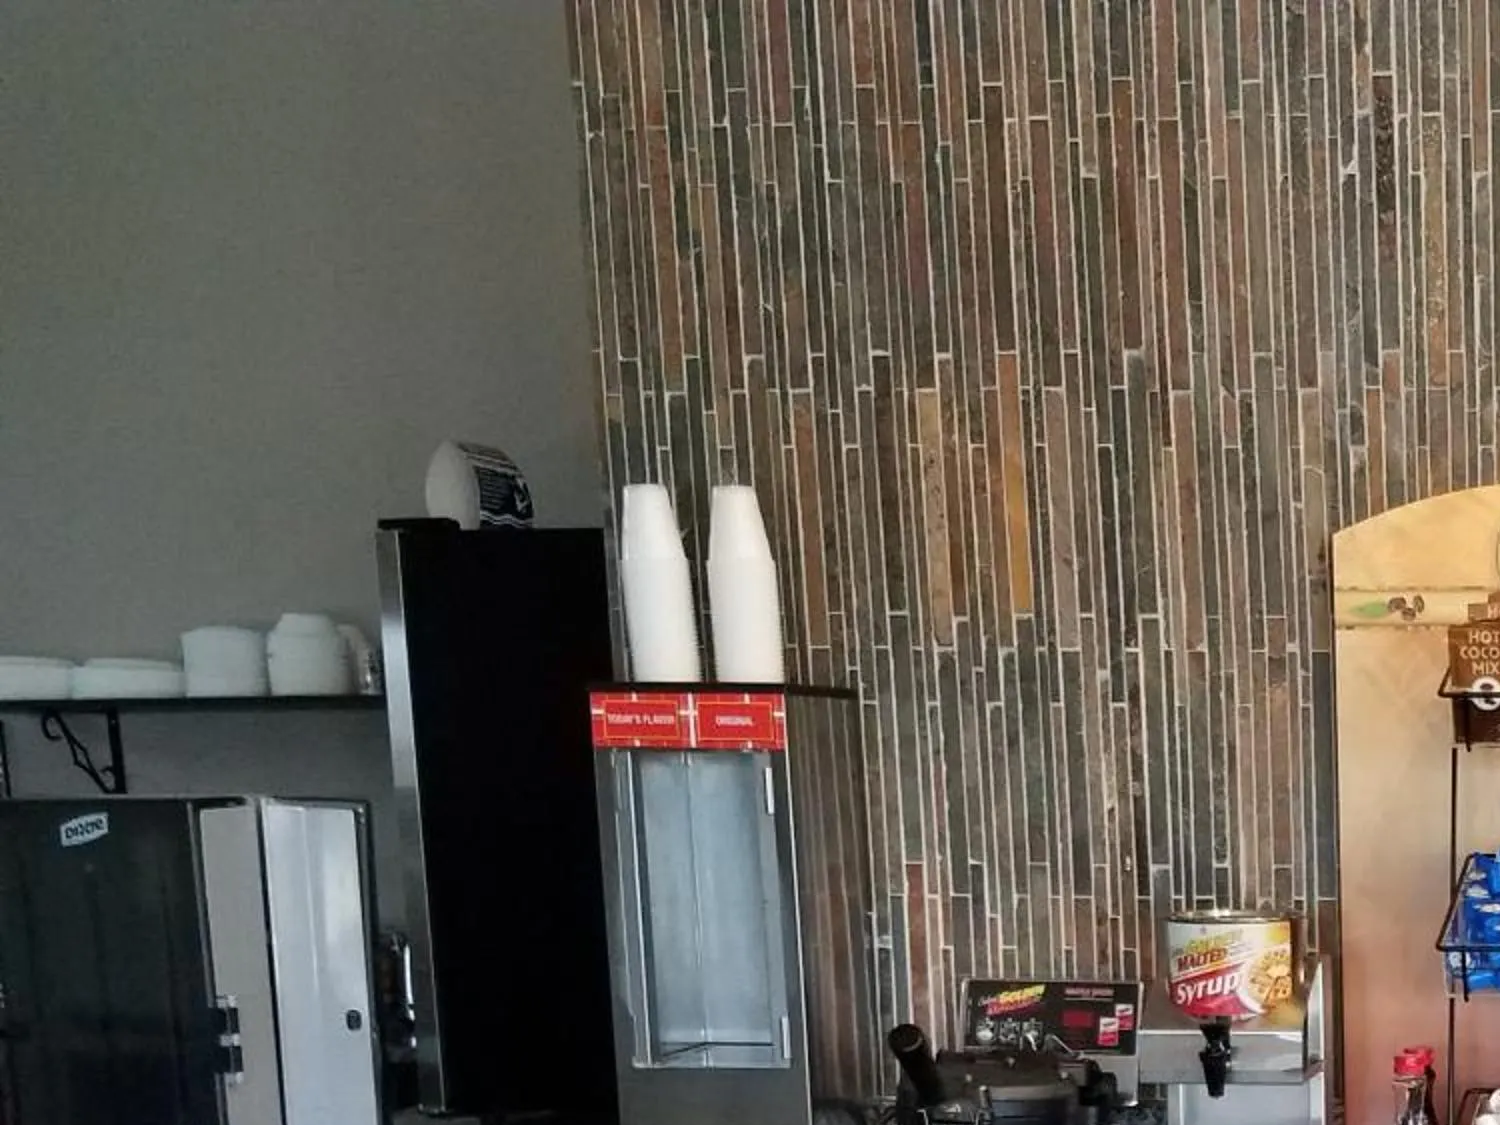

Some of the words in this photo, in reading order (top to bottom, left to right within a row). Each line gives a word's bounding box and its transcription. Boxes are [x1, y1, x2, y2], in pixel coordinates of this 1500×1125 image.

[1467, 628, 1500, 645] HOT
[1471, 660, 1500, 677] MIX
[1176, 972, 1242, 1005] Syrup
